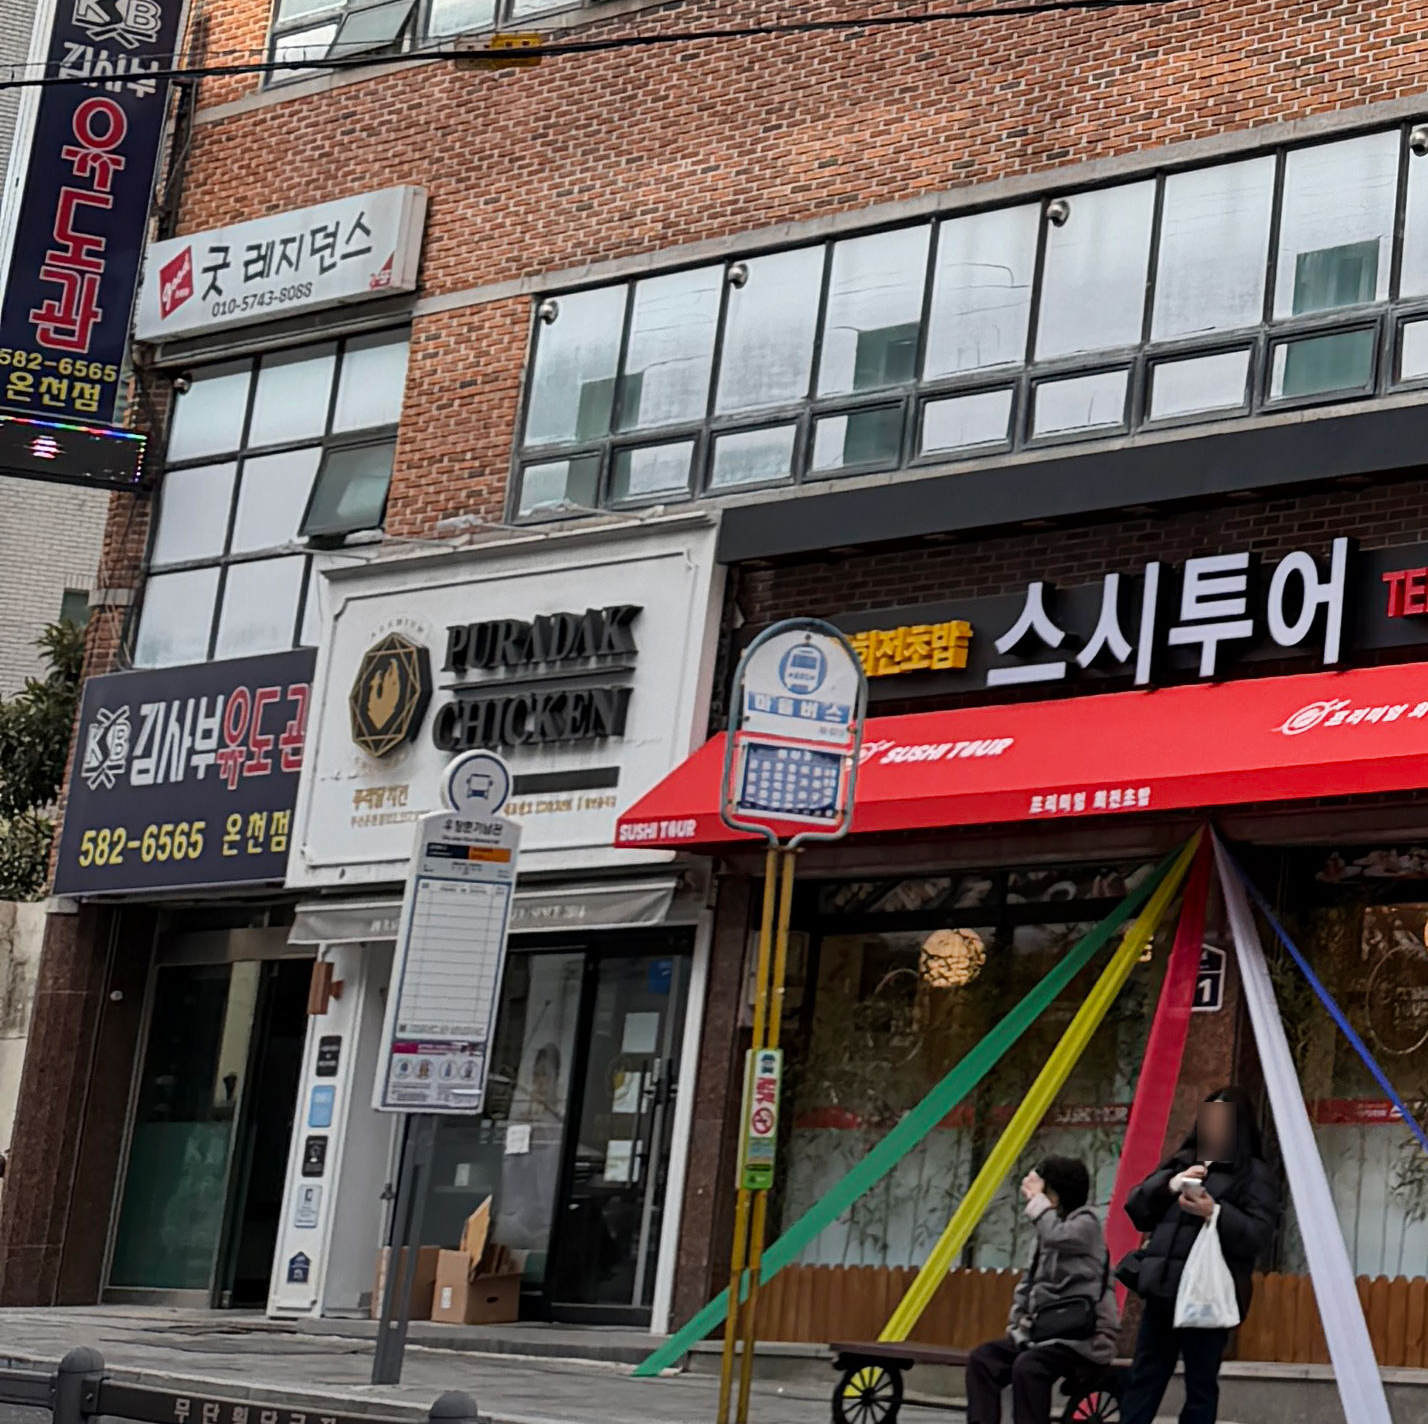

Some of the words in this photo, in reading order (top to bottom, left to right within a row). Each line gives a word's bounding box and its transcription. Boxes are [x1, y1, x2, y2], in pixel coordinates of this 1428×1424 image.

[28, 97, 128, 354] 유도관
[201, 246, 230, 301] 굿
[243, 211, 373, 283] 레지던스
[211, 281, 313, 318] 010-5743-8088
[0, 348, 118, 382] 582-6565
[6, 371, 101, 412] 온천점
[985, 536, 1360, 687] 스시투어
[441, 604, 644, 673] PURADAK
[432, 685, 635, 753] CHICKEN
[754, 694, 844, 722] 마을버스
[880, 743, 949, 765] SUSHI
[79, 822, 206, 867] 582-6565
[222, 810, 292, 856] 온천점
[618, 822, 658, 842] SUSHI
